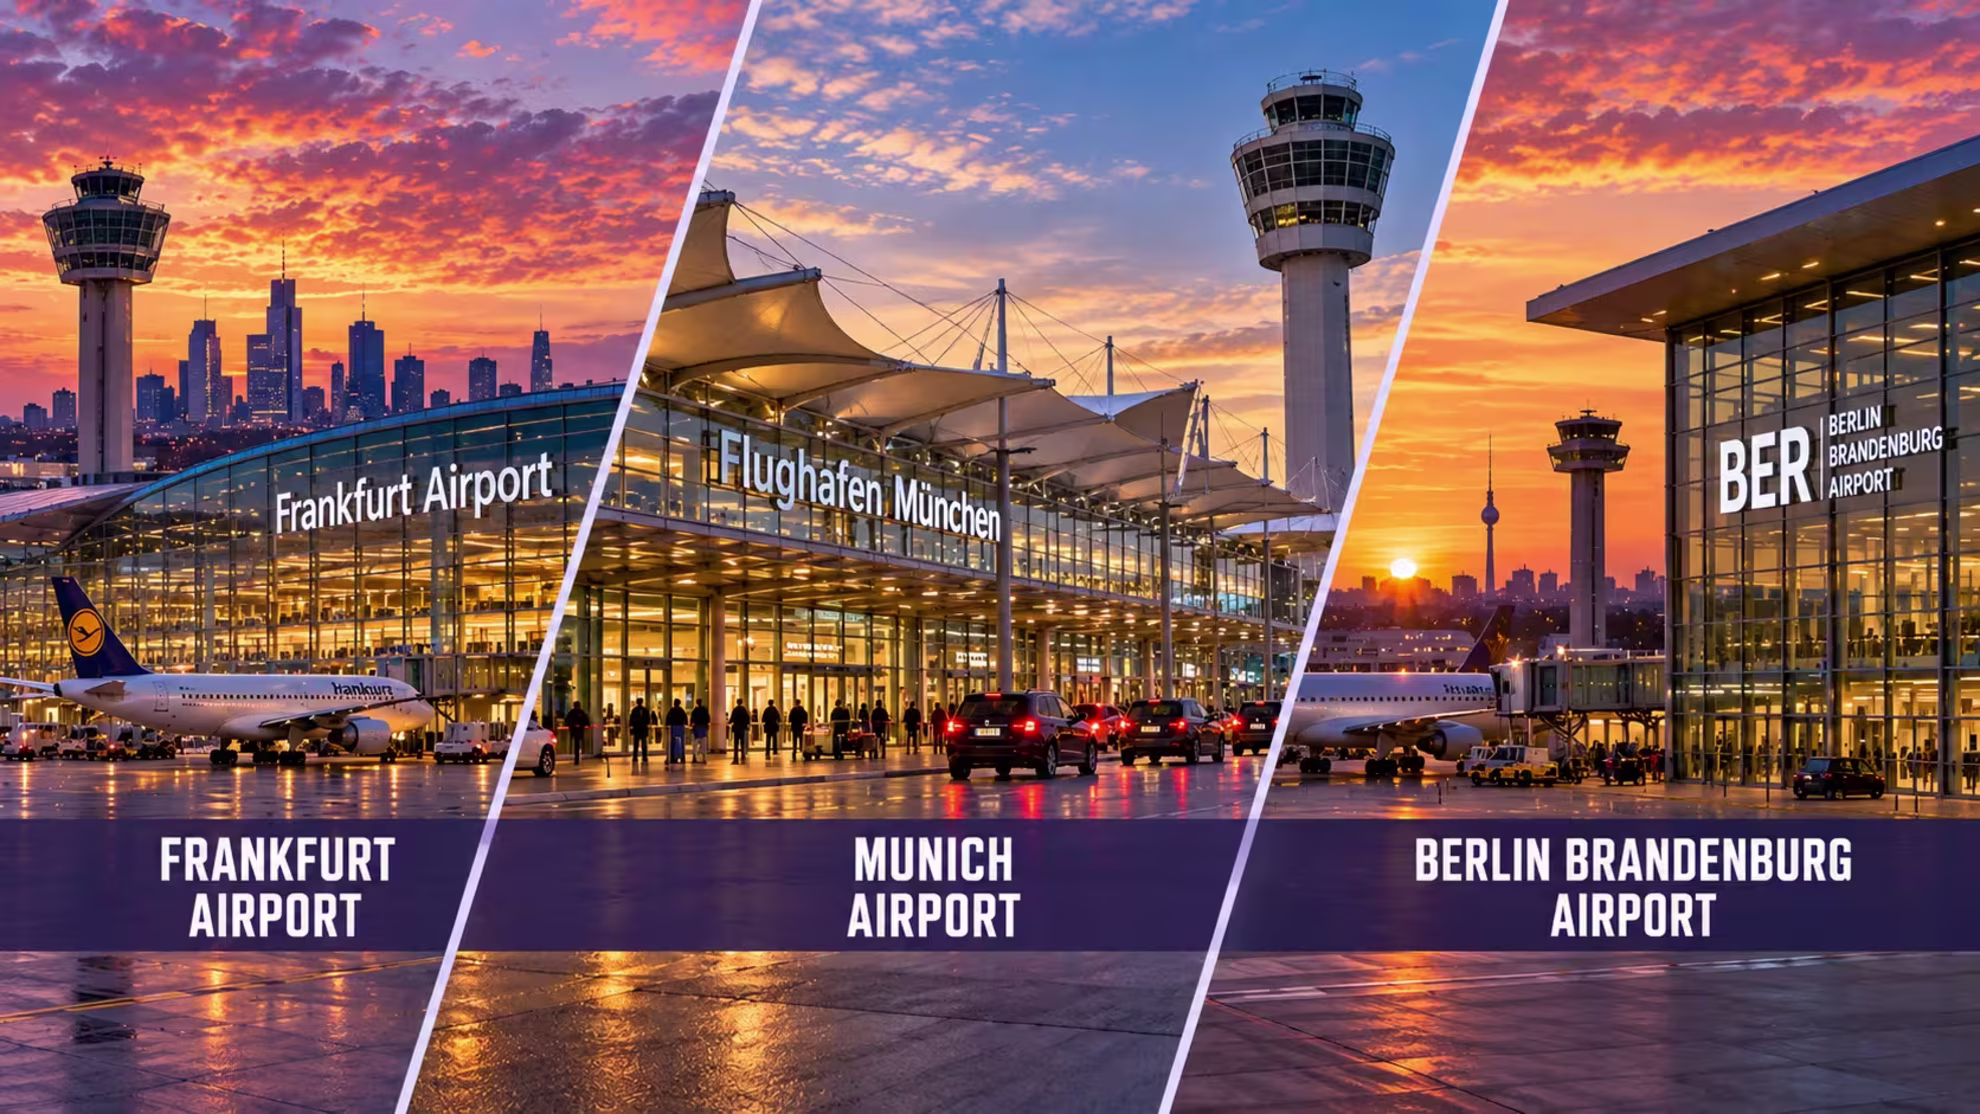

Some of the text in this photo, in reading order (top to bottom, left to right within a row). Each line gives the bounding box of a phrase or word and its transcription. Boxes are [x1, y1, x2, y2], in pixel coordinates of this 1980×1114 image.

[1829, 405, 1881, 436] BERLIN
[1829, 425, 1943, 467] BRANDENBURG
[276, 453, 553, 534] Frankfurt Airport
[720, 429, 1001, 542] Flughafen München
[1720, 426, 1812, 514] BER
[1829, 468, 1893, 498] AIRPORT
